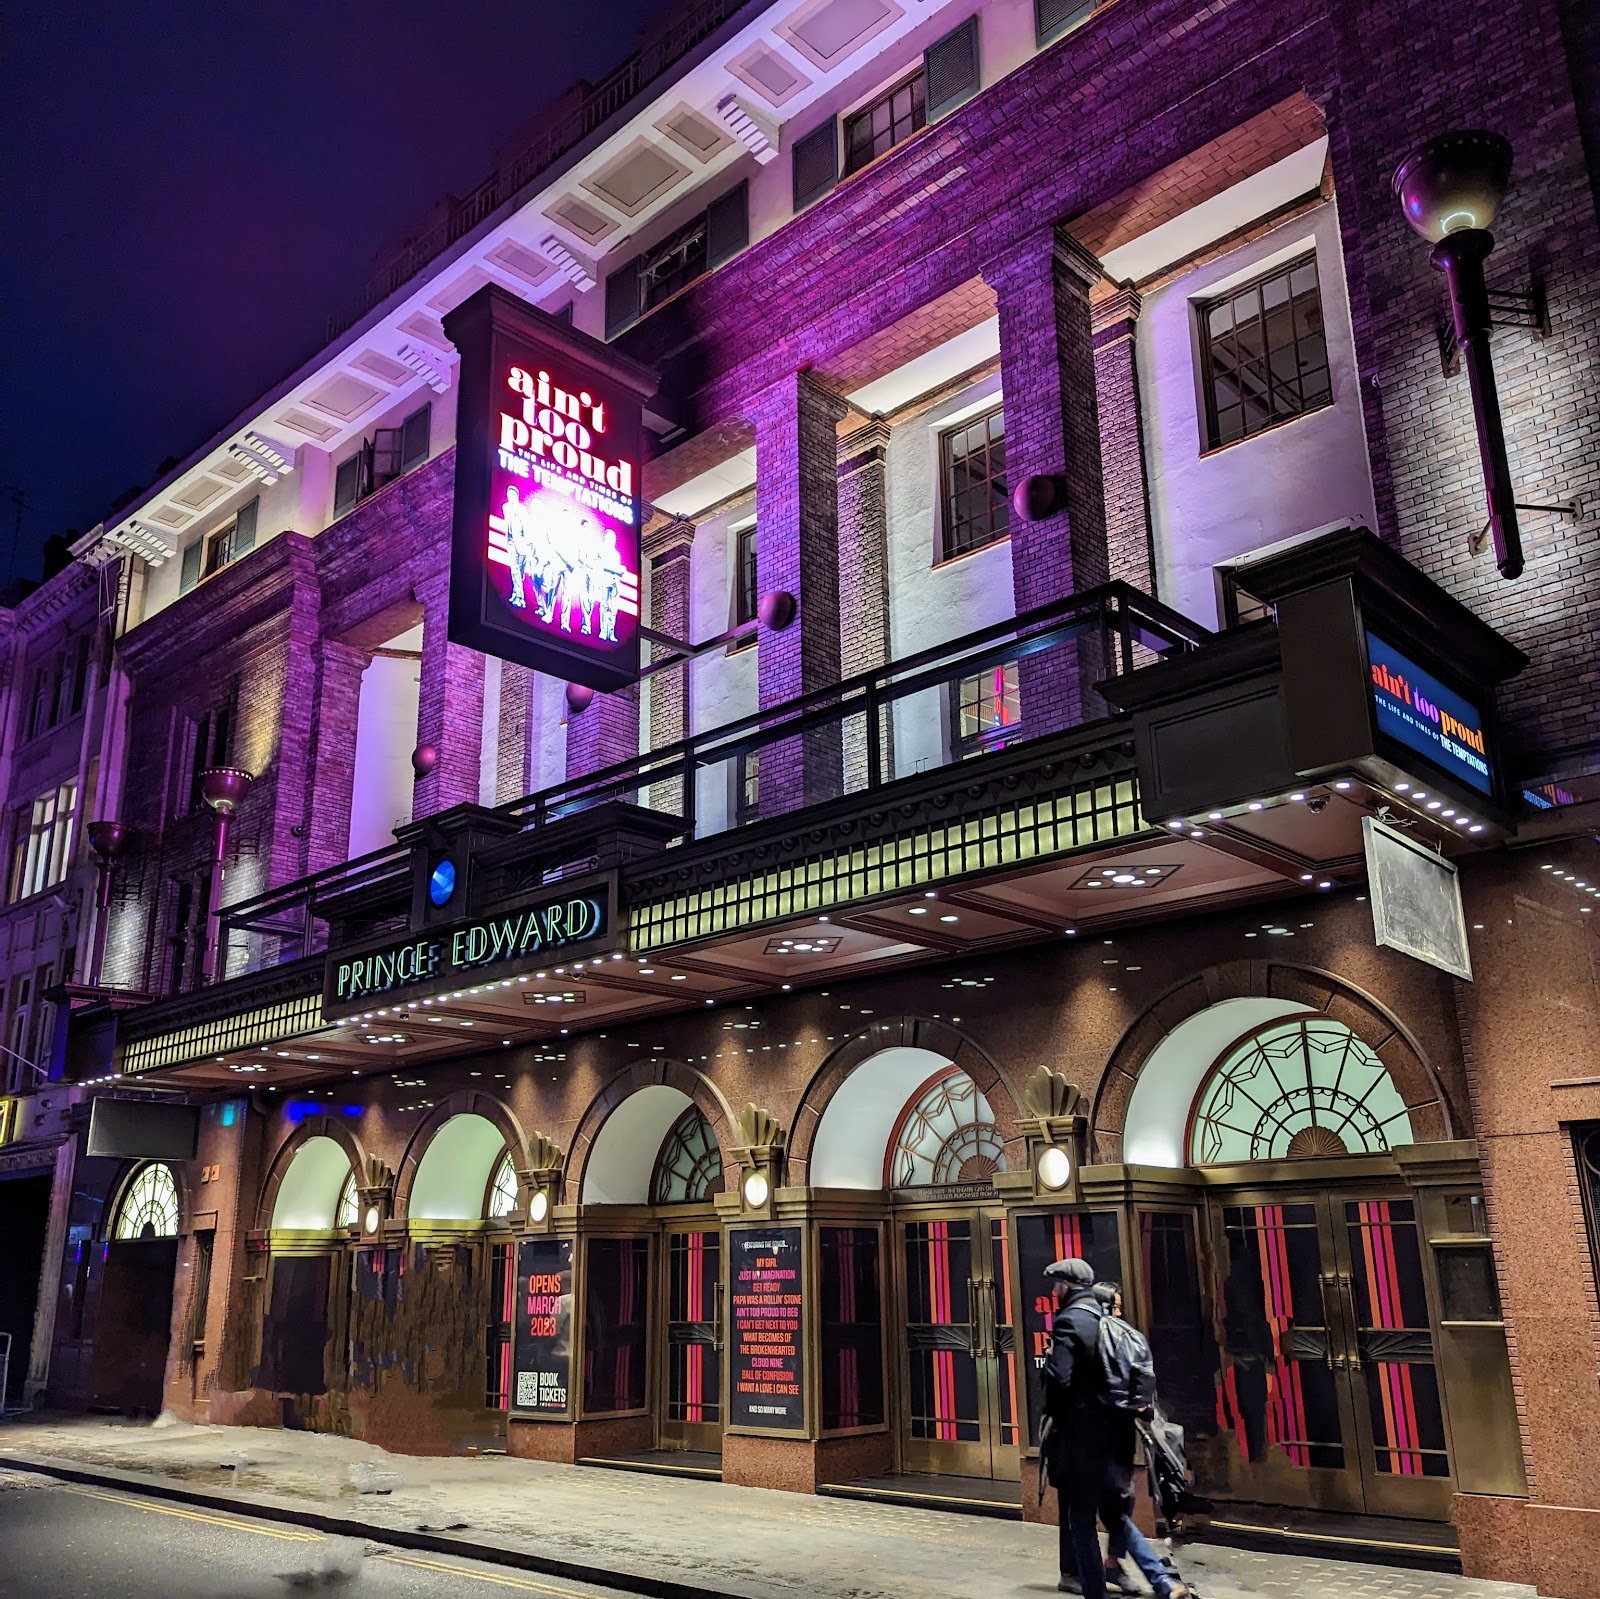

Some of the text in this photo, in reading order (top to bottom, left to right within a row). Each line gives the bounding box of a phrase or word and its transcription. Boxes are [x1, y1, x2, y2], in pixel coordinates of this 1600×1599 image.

[508, 366, 606, 434] ain't
[521, 389, 591, 450] too
[499, 411, 633, 498] proud
[540, 458, 562, 474] LIFE
[565, 470, 586, 484] AND
[589, 480, 617, 500] TIMES
[498, 448, 634, 525] THE TEMPTATIONS
[1371, 663, 1486, 756] ain't too proud
[1374, 694, 1489, 777] THE LIFE AND TIMES OF THE TEMPTATIONS
[337, 898, 593, 998] PRINCE EDWARD
[756, 1258, 778, 1266] MY GIRL
[738, 1270, 752, 1280] JUST
[761, 1270, 796, 1280] IMAGINATION
[529, 1274, 562, 1294] OPENS
[753, 1282, 781, 1292] GET READY
[527, 1296, 563, 1316] MARCH
[733, 1296, 747, 1304] PAPA
[747, 1296, 759, 1304] WAS
[783, 1294, 802, 1304] STONE
[736, 1308, 799, 1316] AIN'T TOO PROUD TO BEG
[530, 1316, 558, 1338] 2023
[740, 1320, 755, 1330] CAN'T
[755, 1320, 765, 1330] GET
[765, 1320, 780, 1330] NEXT
[780, 1320, 787, 1330] TO
[787, 1320, 798, 1330] YOU
[743, 1332, 792, 1342] WHAT BECOMES OF
[740, 1344, 796, 1356] THE BROKENHEARTED
[751, 1358, 784, 1368] CLOUD NINE
[539, 1372, 560, 1386] BOOK
[742, 1370, 794, 1382] BALL OF CONFUSION
[538, 1388, 567, 1402] TICKETS
[740, 1382, 755, 1392] WANT
[760, 1384, 773, 1394] LOVE
[776, 1384, 788, 1394] CAN
[788, 1384, 800, 1394] SEE
[749, 1404, 787, 1416] AND SO MANY MORE
